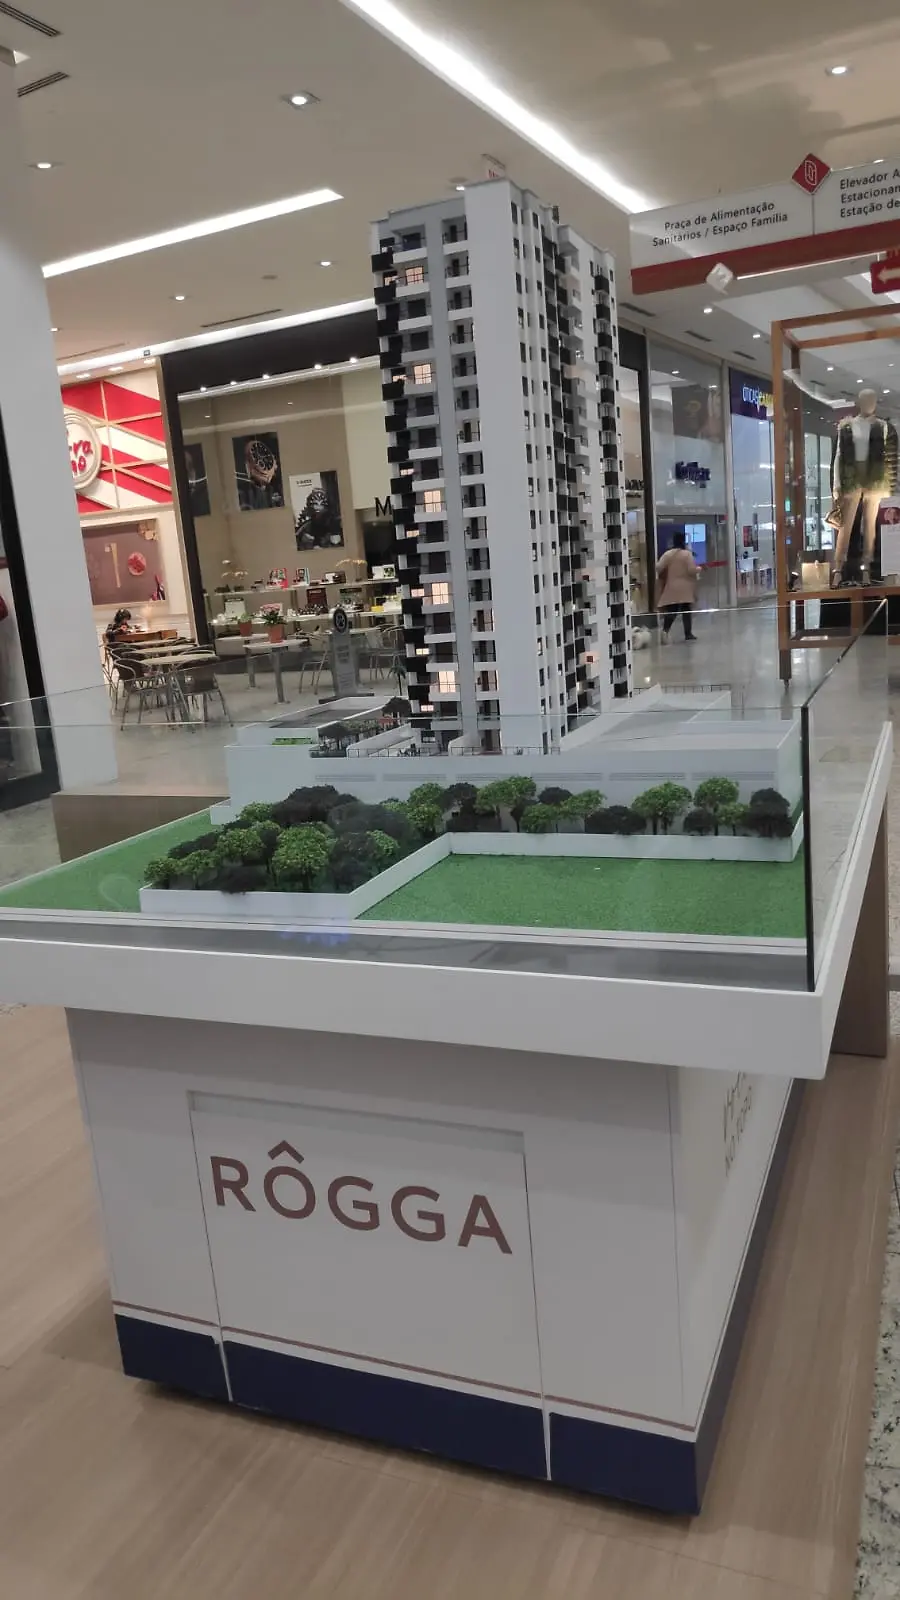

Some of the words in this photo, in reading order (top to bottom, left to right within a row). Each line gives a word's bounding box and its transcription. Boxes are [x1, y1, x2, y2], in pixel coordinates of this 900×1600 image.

[840, 172, 888, 190] Elevador
[664, 218, 691, 230] Praça
[694, 215, 707, 226] de
[710, 201, 775, 222] Alimentação
[840, 202, 883, 218] Estação
[712, 220, 748, 236] Espaço
[210, 1139, 512, 1255] RÔGGA
